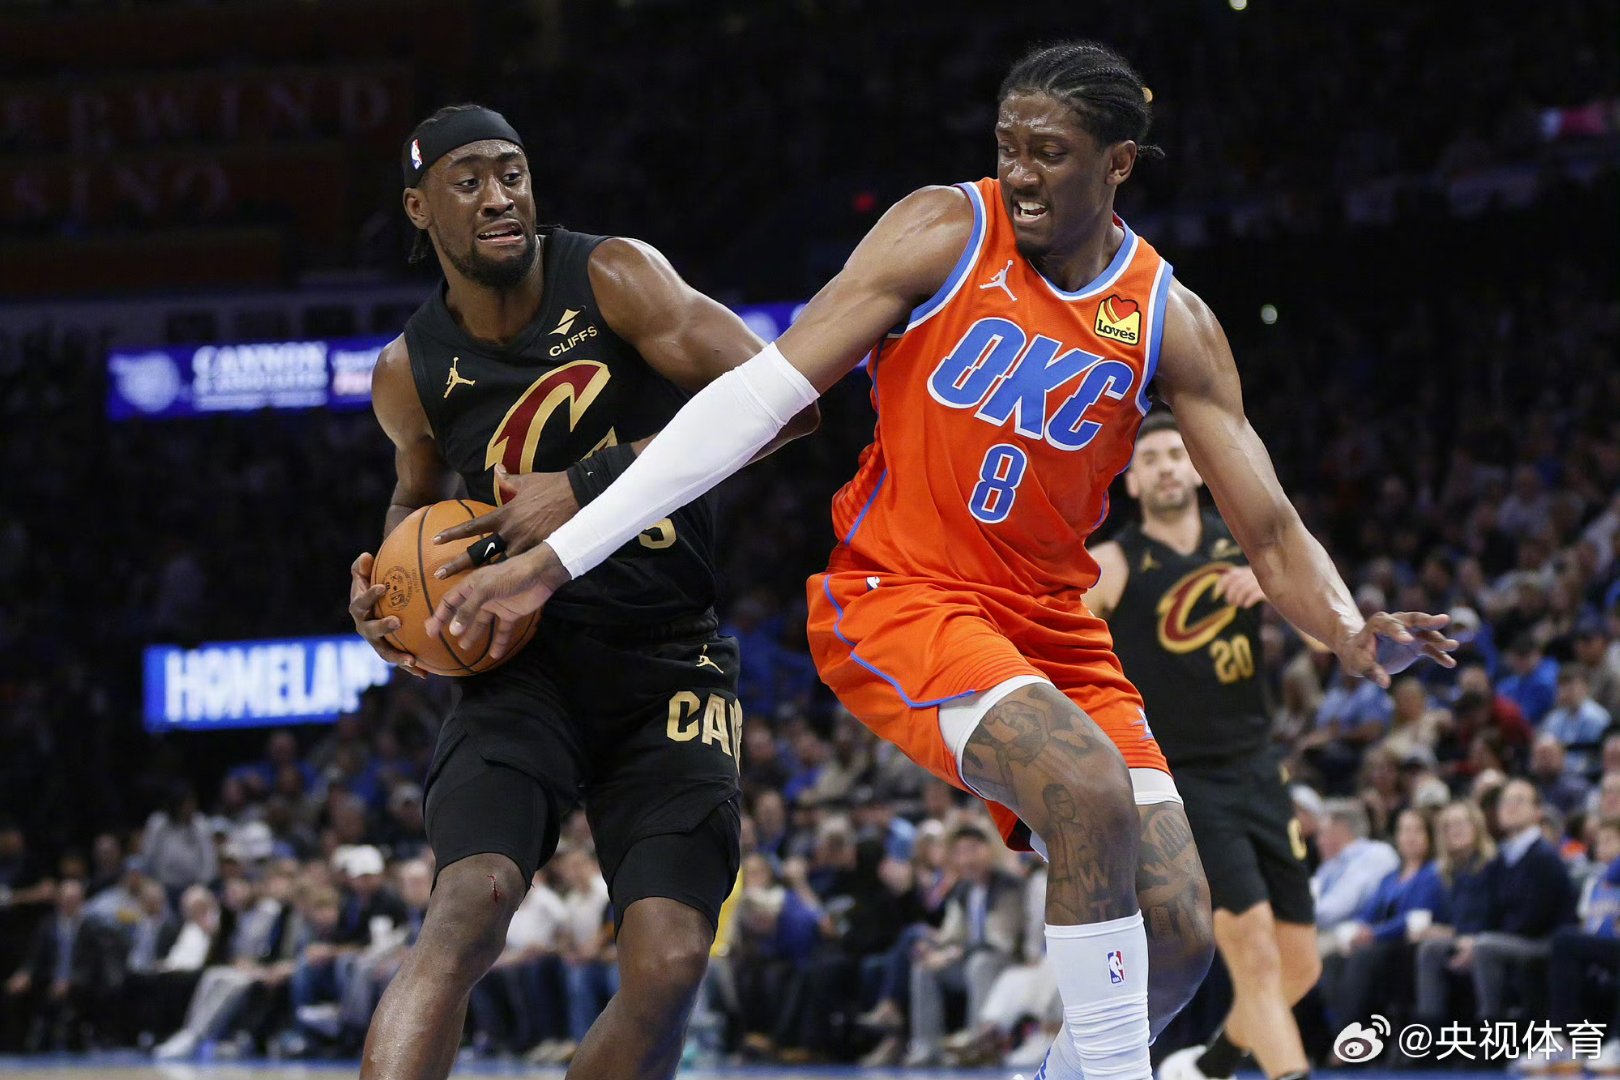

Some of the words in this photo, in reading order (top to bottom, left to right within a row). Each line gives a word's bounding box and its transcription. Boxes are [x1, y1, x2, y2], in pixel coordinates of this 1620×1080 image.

[549, 325, 598, 357] CLIFFS
[926, 316, 1135, 452] OKC
[968, 443, 1028, 524] 8
[1210, 634, 1255, 684] 20
